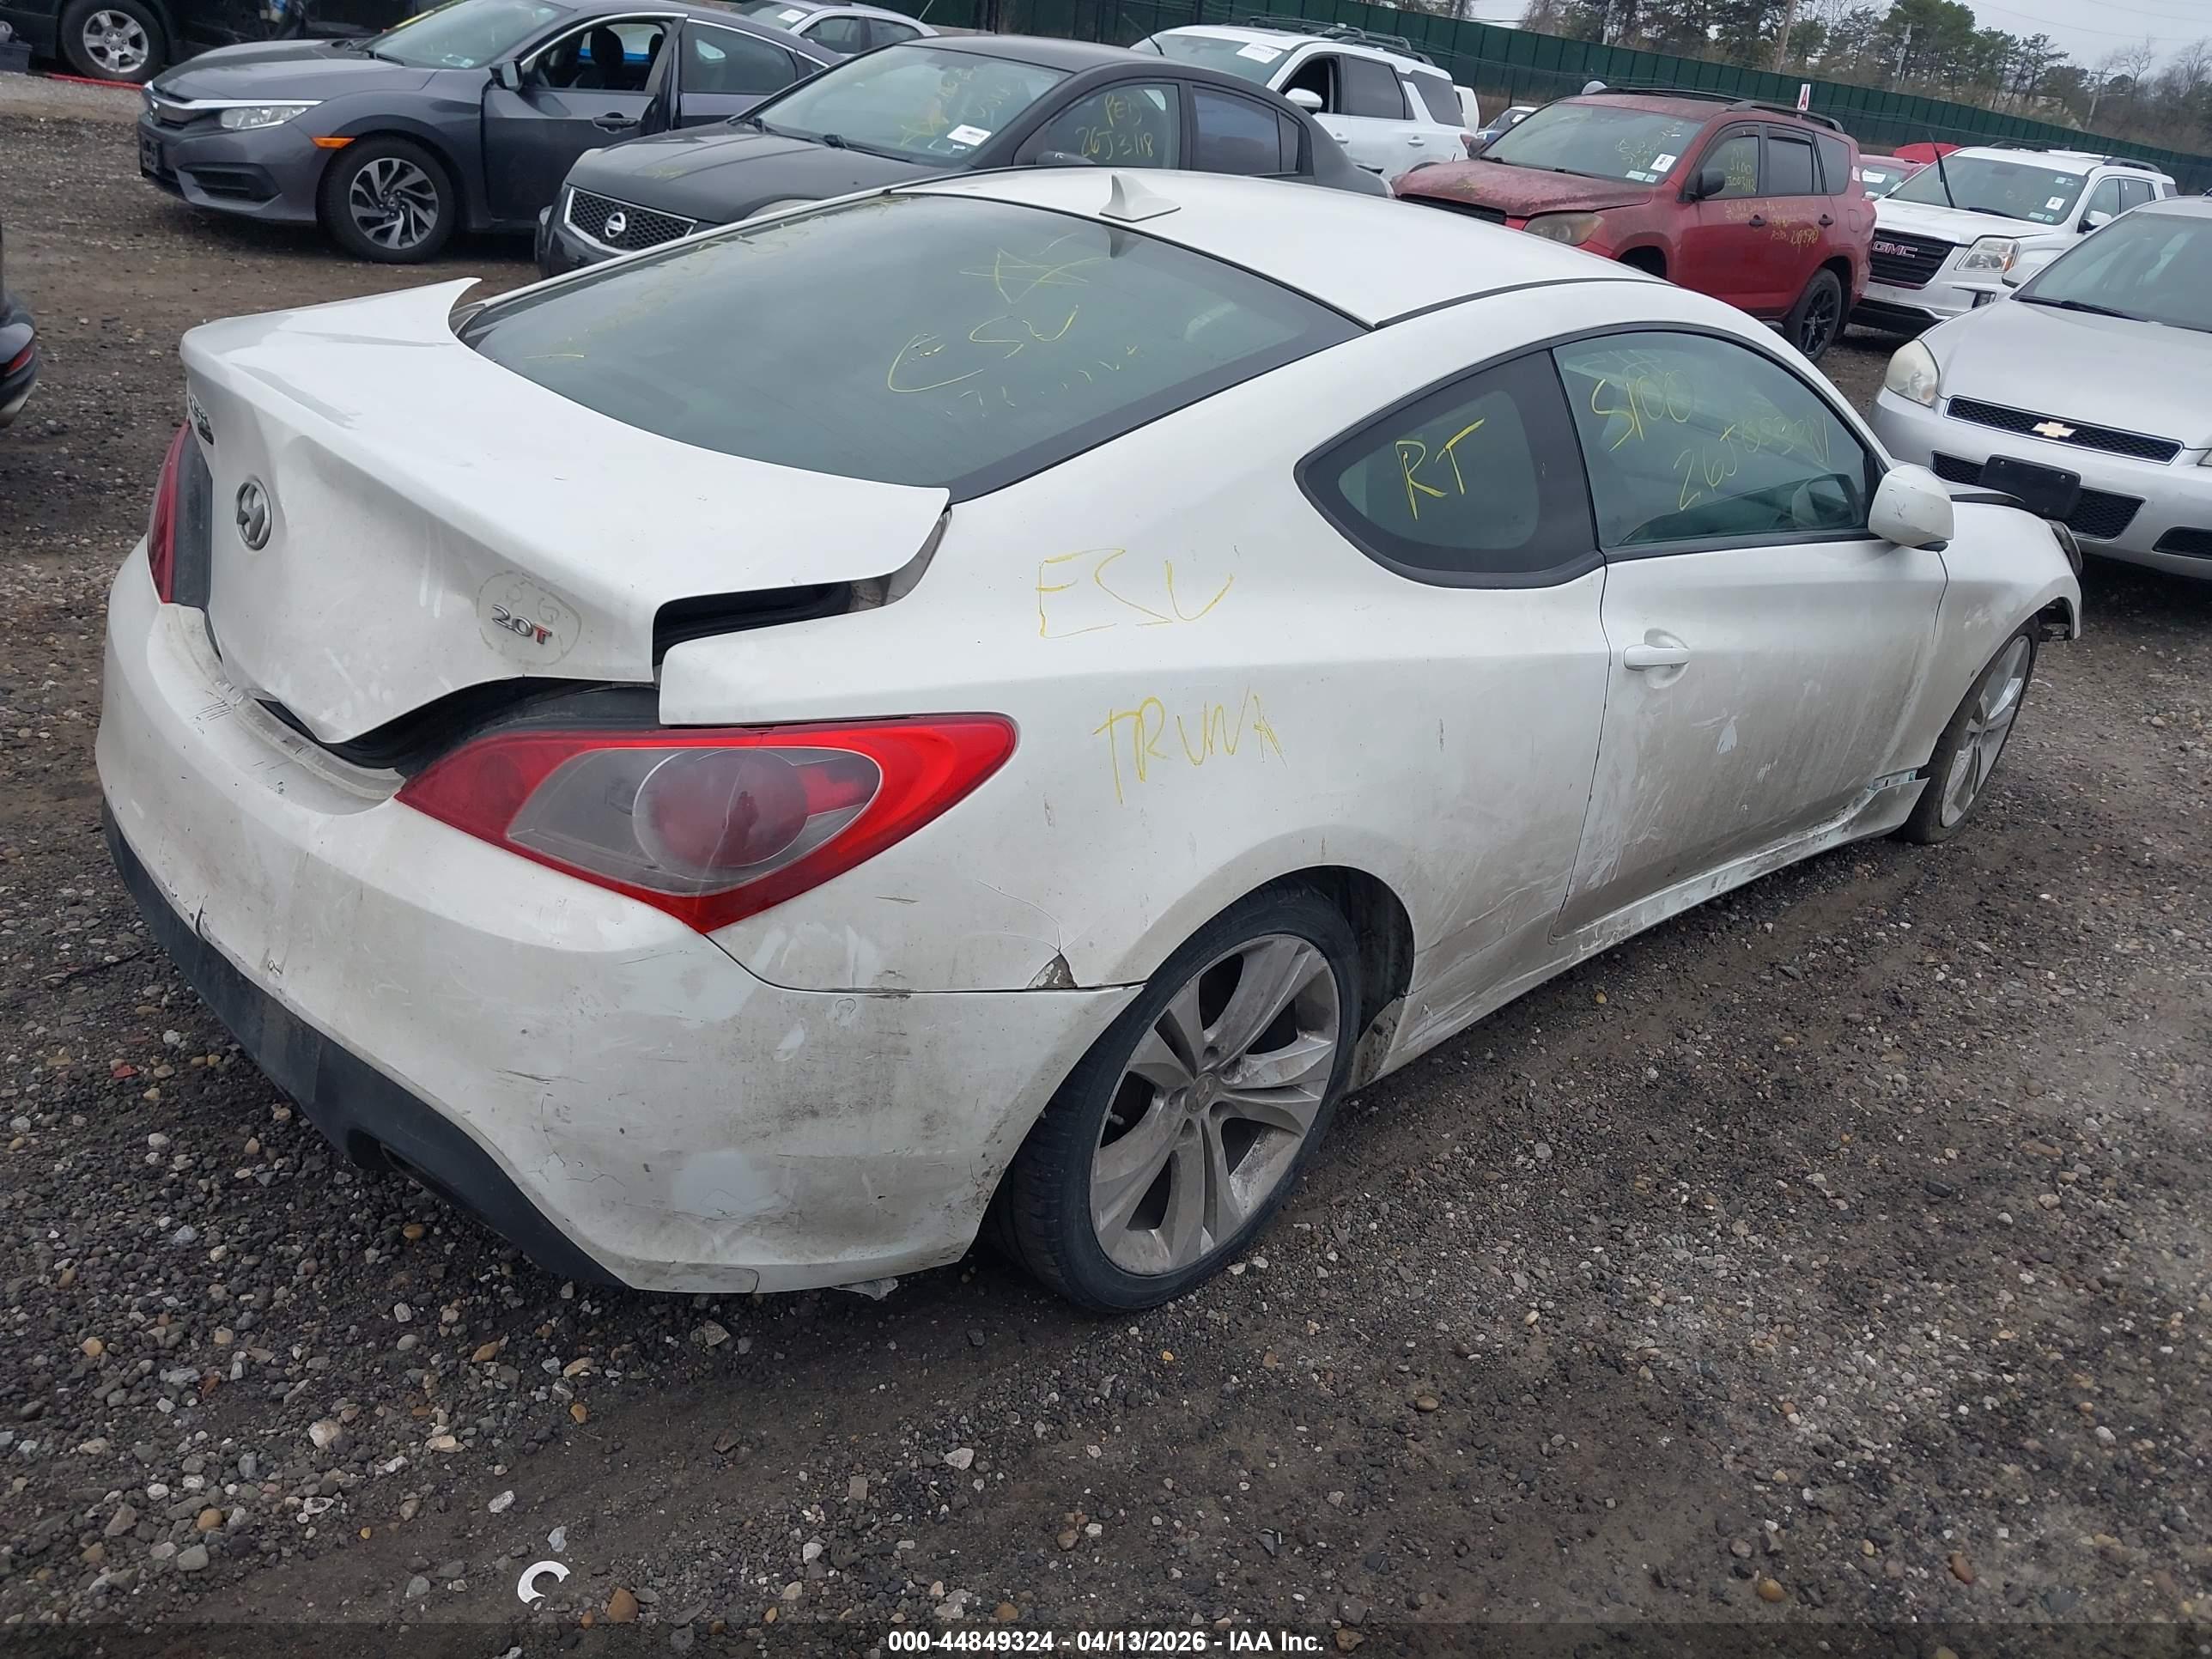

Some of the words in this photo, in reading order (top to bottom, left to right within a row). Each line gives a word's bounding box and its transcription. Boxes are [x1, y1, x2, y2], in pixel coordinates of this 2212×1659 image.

[1800, 87, 1808, 108] A
[1871, 240, 1918, 258] GMC
[1395, 417, 1486, 520] RT
